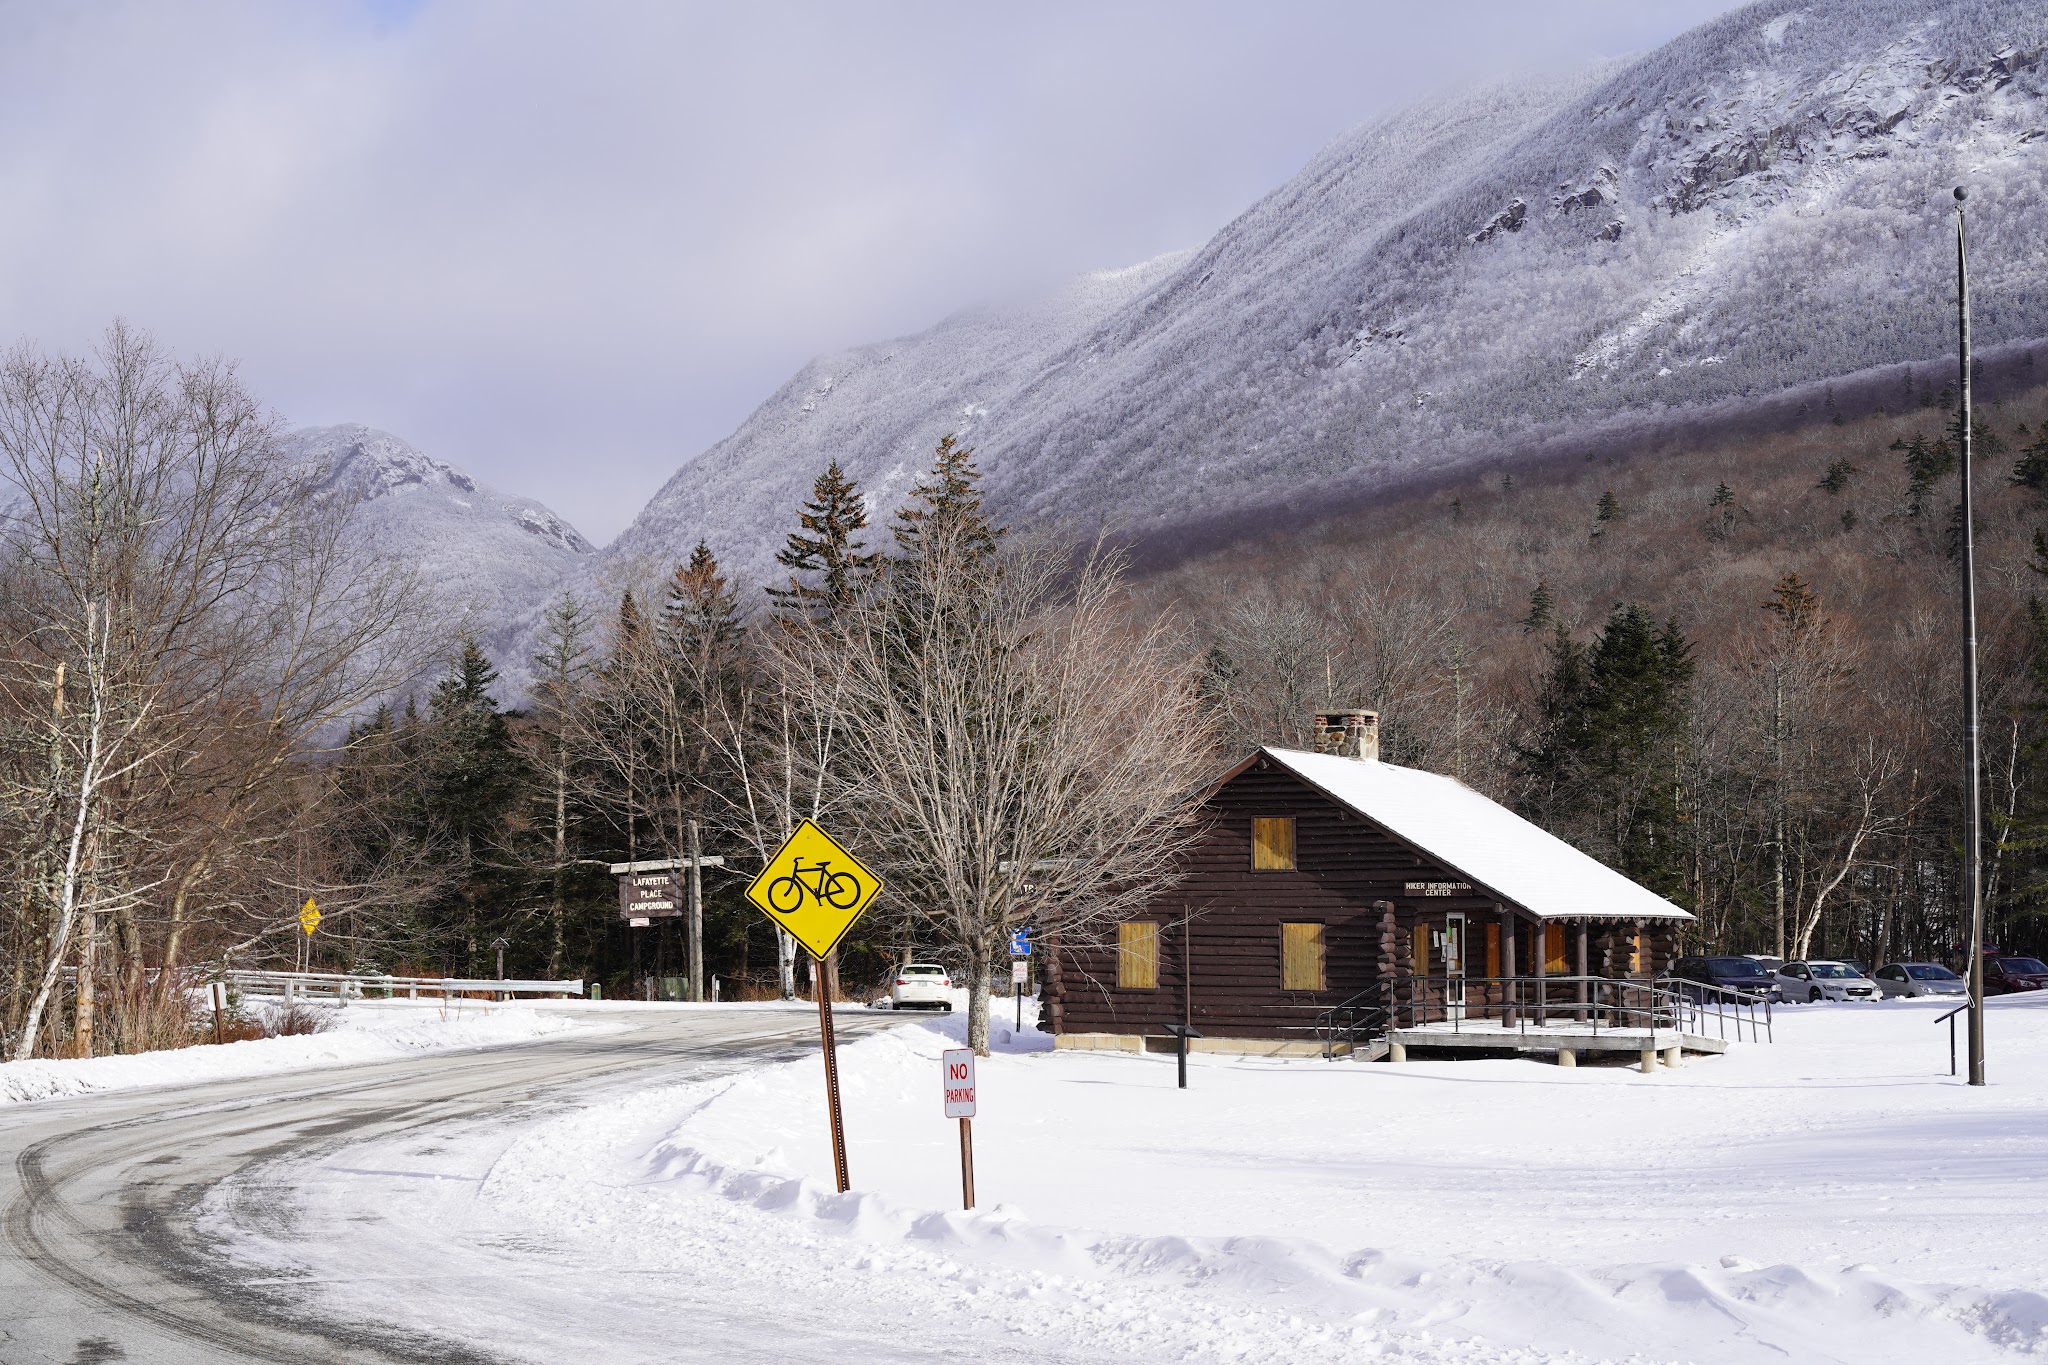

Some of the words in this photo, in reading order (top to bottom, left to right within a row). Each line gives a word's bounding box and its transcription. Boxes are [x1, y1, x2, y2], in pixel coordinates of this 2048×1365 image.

[632, 876, 670, 887] LAFAYETTE
[1405, 882, 1425, 890] HIKER
[1427, 882, 1472, 890] INFORMATION
[640, 889, 663, 899] PLACE
[1425, 889, 1452, 897] CENTER
[629, 901, 674, 911] CAMPGROUND
[950, 1063, 968, 1080] NO
[946, 1087, 974, 1104] PARKING
